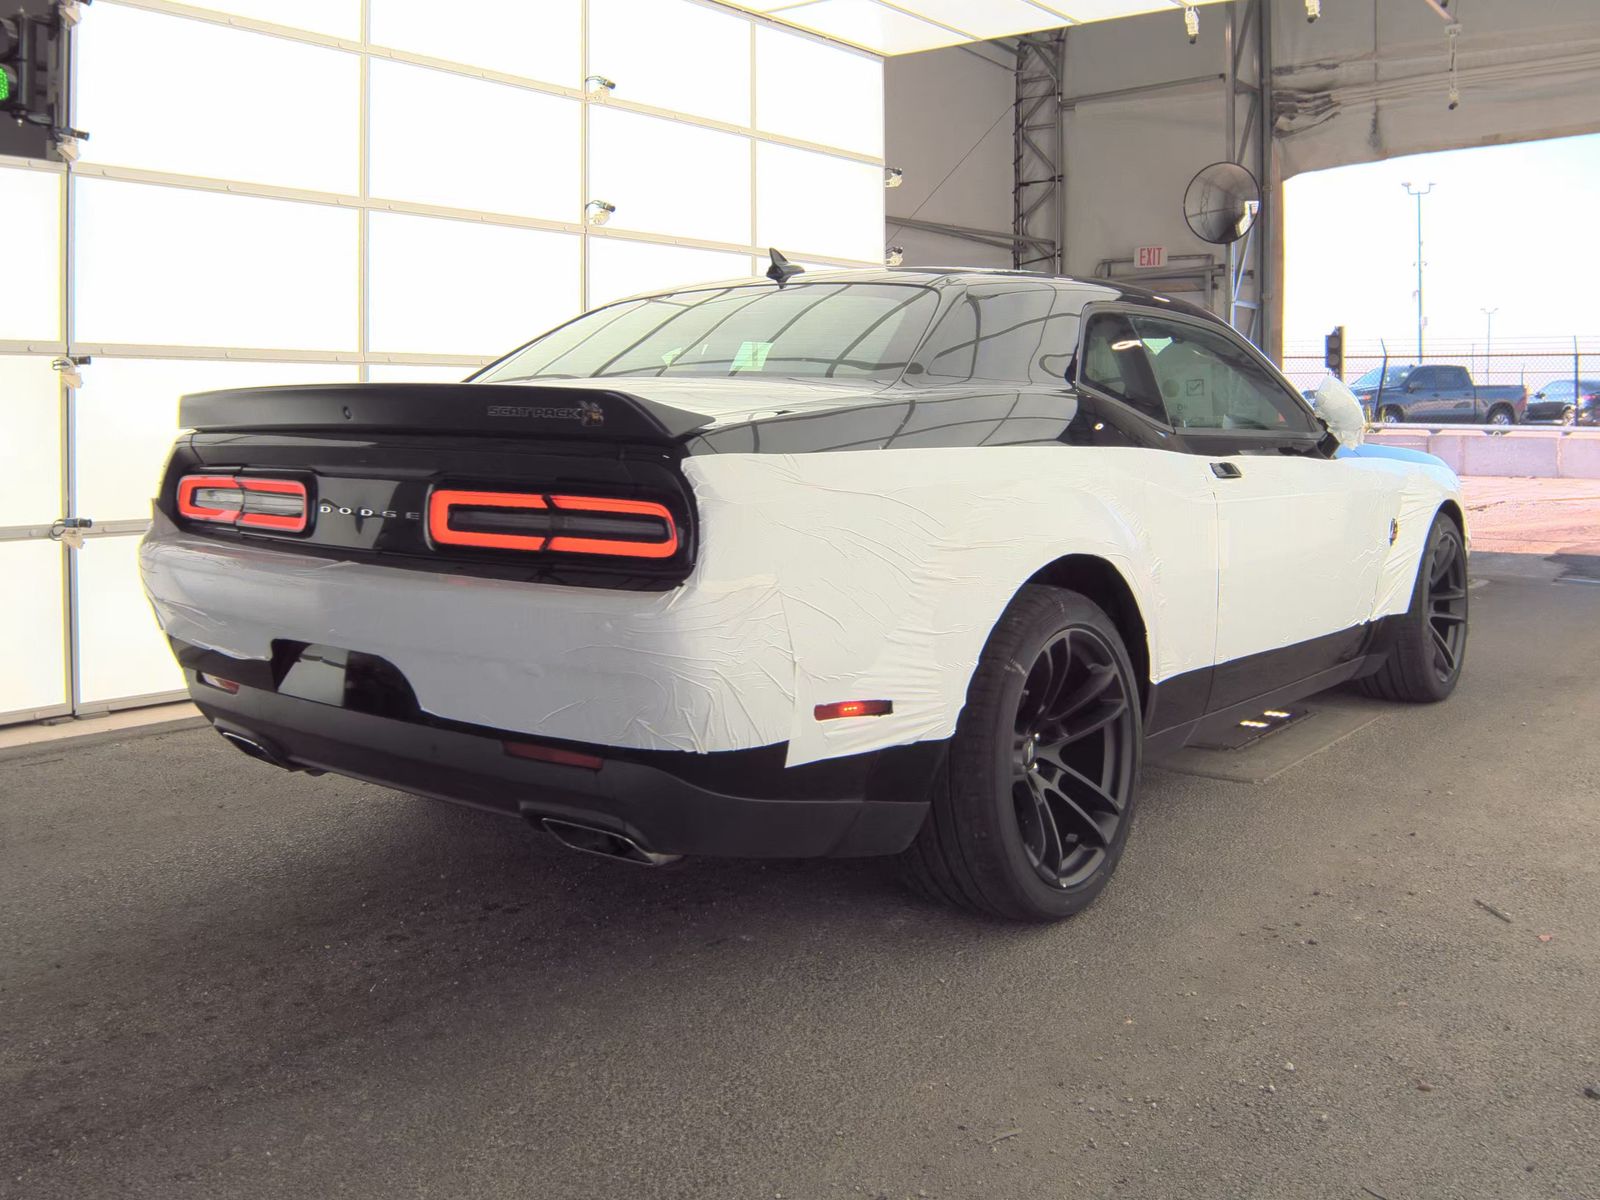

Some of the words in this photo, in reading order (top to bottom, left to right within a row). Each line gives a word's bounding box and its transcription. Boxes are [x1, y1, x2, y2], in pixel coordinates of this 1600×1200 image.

[1140, 247, 1162, 266] EXIT
[487, 405, 531, 417] SCAT
[534, 407, 582, 419] PACK
[320, 506, 419, 520] DODGE
